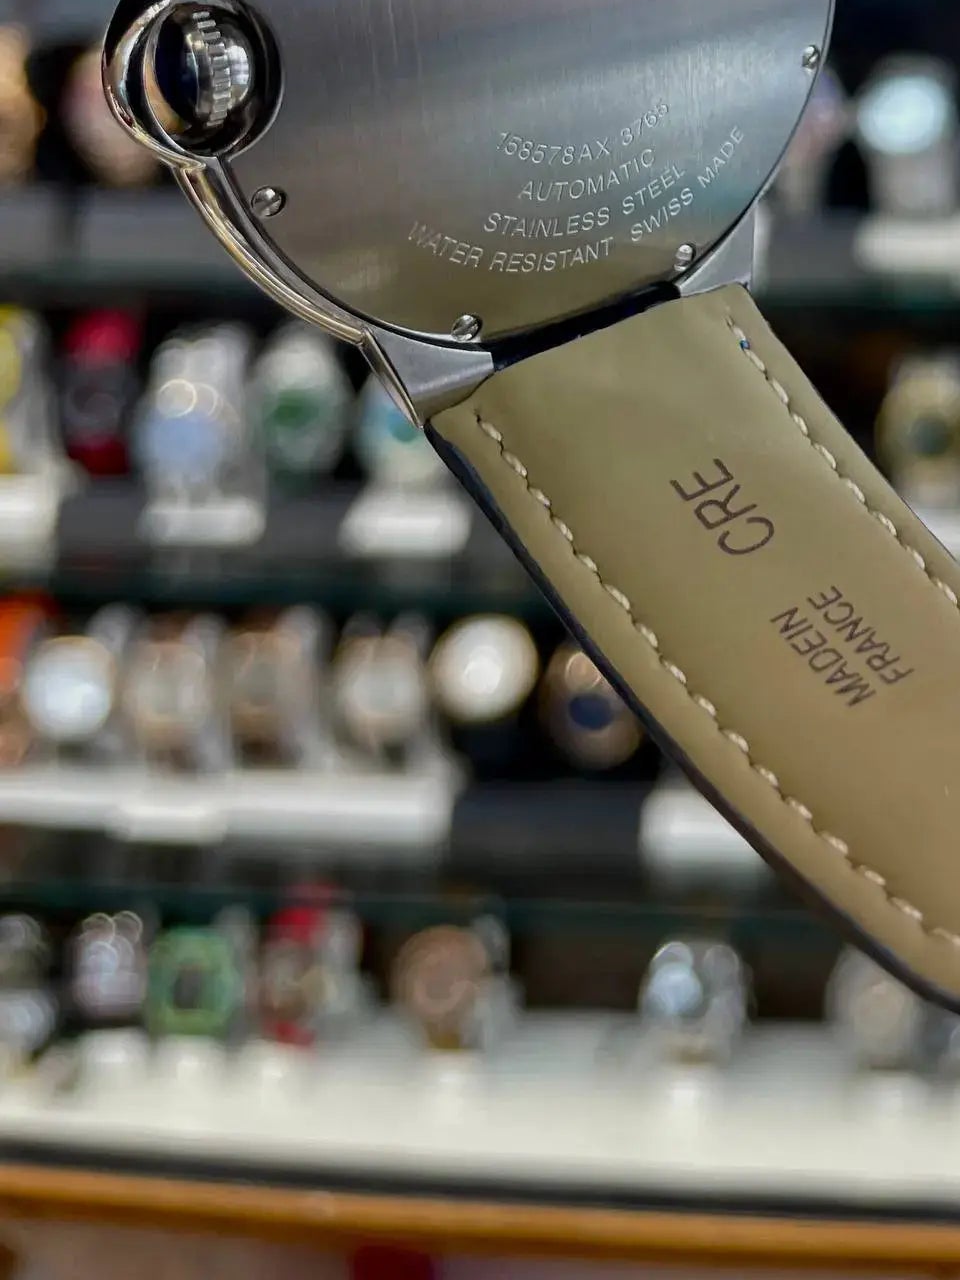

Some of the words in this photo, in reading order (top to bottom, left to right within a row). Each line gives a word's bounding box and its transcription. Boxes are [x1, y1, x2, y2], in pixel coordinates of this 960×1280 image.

[408, 220, 484, 268] WATER
[489, 236, 614, 273] RESISTANT
[631, 186, 694, 243] SWISS
[697, 125, 746, 189] MADE
[483, 206, 610, 239] STAINLESS
[622, 163, 686, 216] STEEL
[517, 148, 656, 202] AUTOMATIC
[669, 457, 775, 556] CRE
[806, 585, 914, 686] FRANCE
